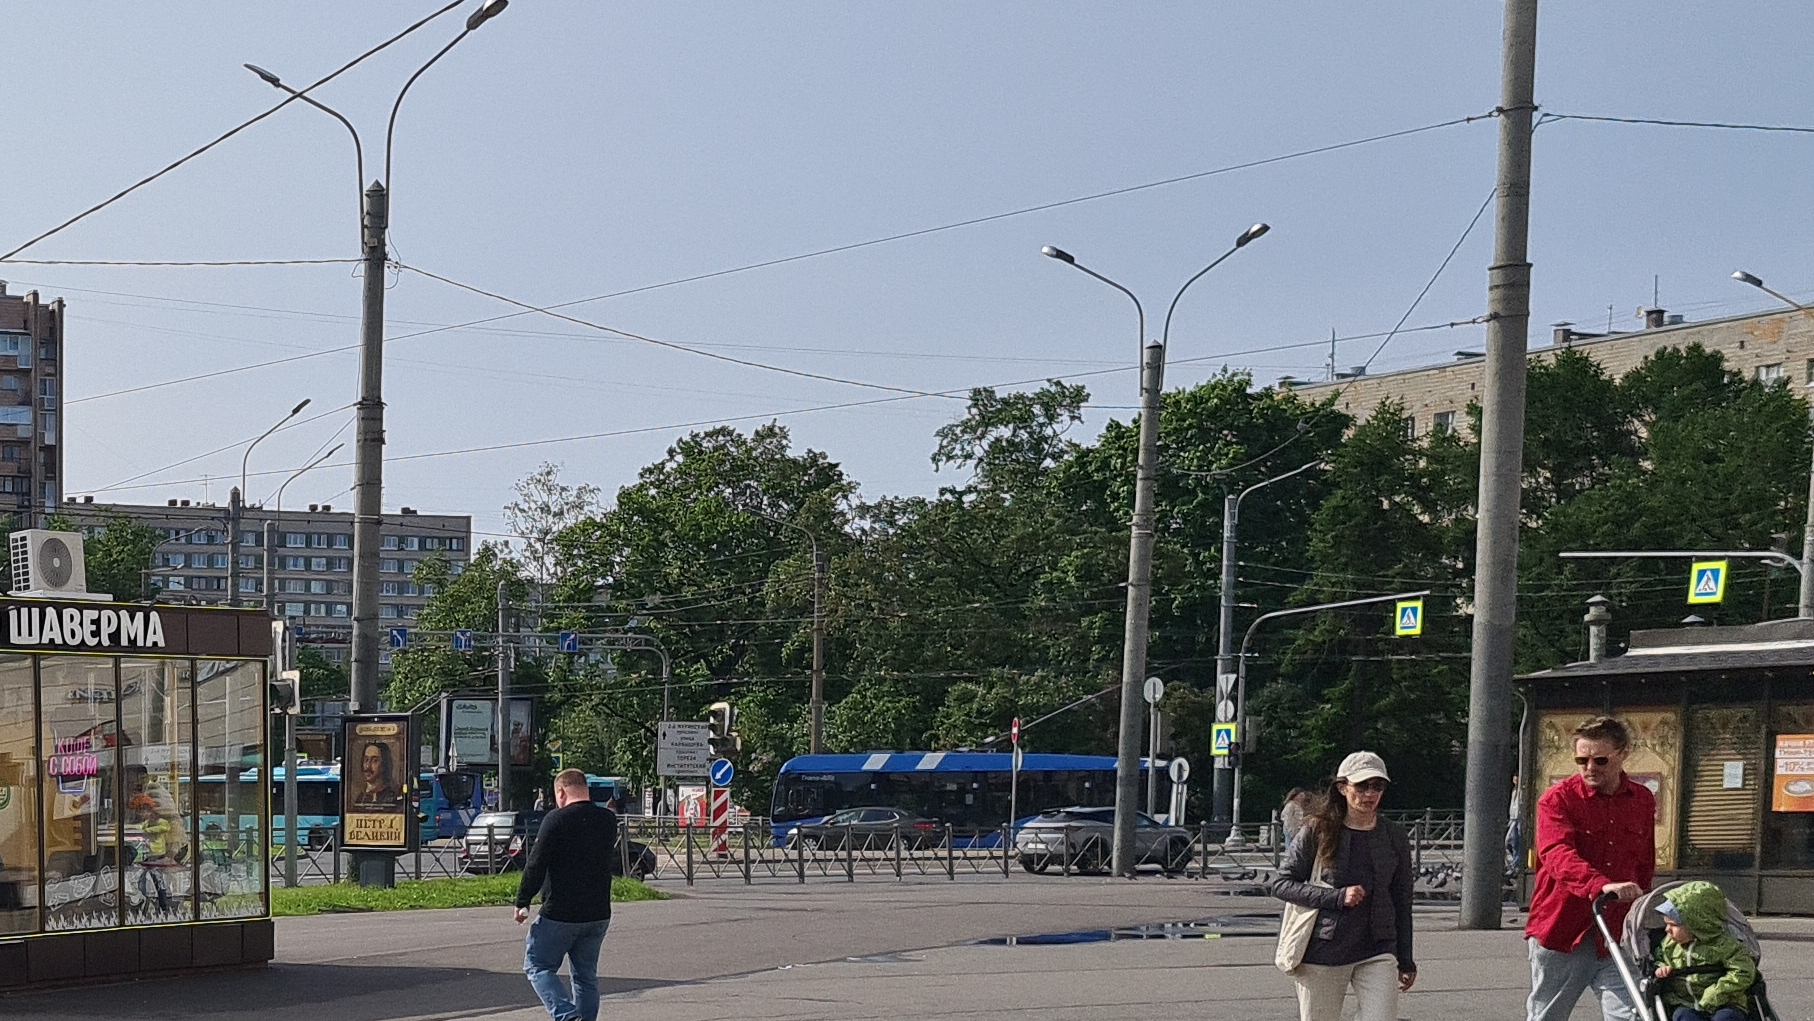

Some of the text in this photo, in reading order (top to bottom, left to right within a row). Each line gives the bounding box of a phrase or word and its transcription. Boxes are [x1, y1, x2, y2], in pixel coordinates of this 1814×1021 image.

[9, 604, 166, 648] ШАВЕРМА
[57, 736, 91, 755] КОФЕ
[49, 753, 98, 775] С СОБОЙ
